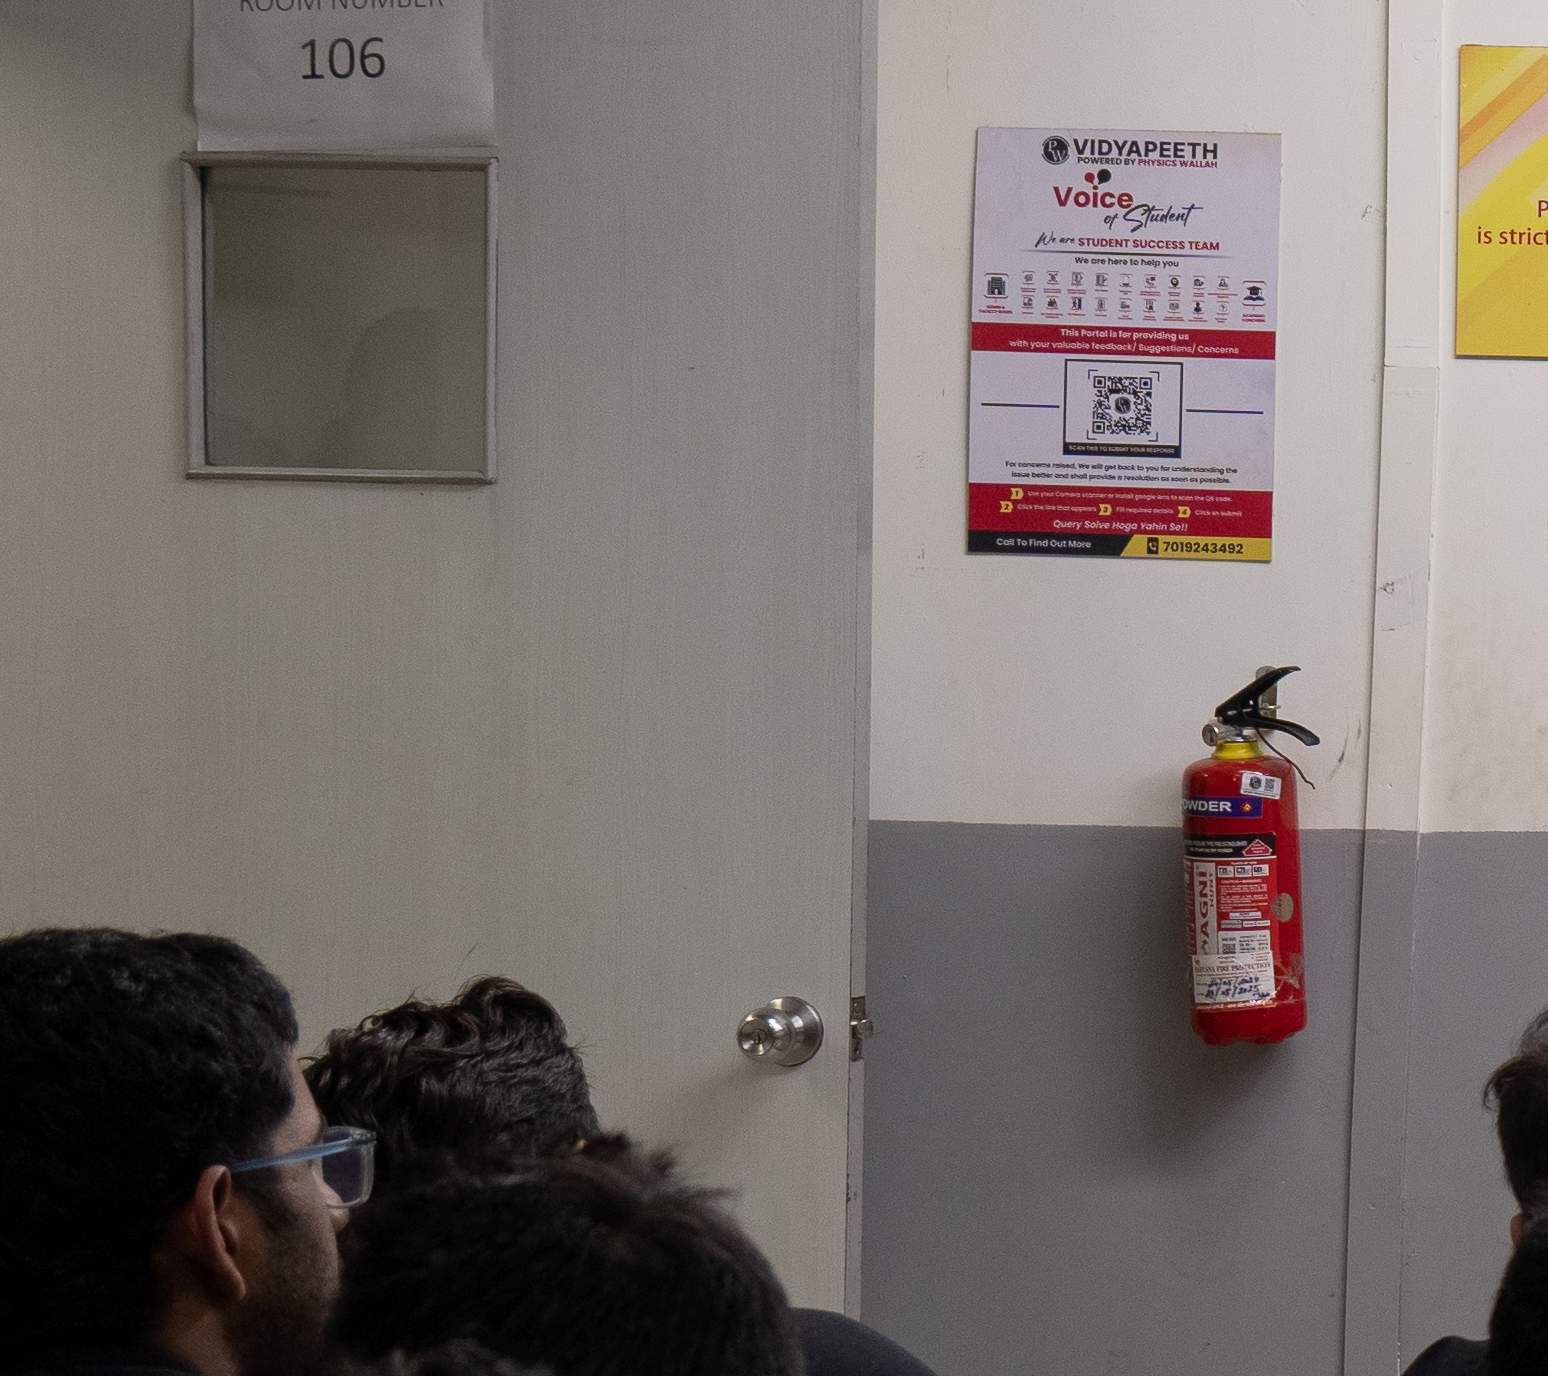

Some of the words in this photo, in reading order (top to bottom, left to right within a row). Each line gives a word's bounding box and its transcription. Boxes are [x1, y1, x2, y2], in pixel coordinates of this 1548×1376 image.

[300, 36, 387, 81] 106
[1073, 138, 1218, 160] VIDYAPEETH
[1076, 156, 1122, 165] POWERED
[1123, 157, 1136, 166] BY
[1137, 158, 1177, 167] PHYSICS
[1178, 159, 1217, 168] WALLAH
[1053, 185, 1134, 210] Voice
[1103, 213, 1117, 231] of
[1123, 203, 1204, 232] Student
[1077, 237, 1130, 248] STUDENT
[1132, 238, 1185, 250] SUCCESS
[1187, 240, 1220, 251] TEAM
[1477, 227, 1492, 245] is
[1074, 256, 1089, 264] We
[1107, 257, 1128, 266] here
[1129, 258, 1139, 266] to
[1140, 258, 1161, 268] help
[1161, 260, 1179, 269] you
[996, 537, 1015, 546] Call
[1016, 538, 1028, 546] To
[1028, 538, 1049, 547] Find
[1049, 539, 1067, 548] Out
[1067, 539, 1092, 548] More
[1162, 540, 1243, 554] 7019243492
